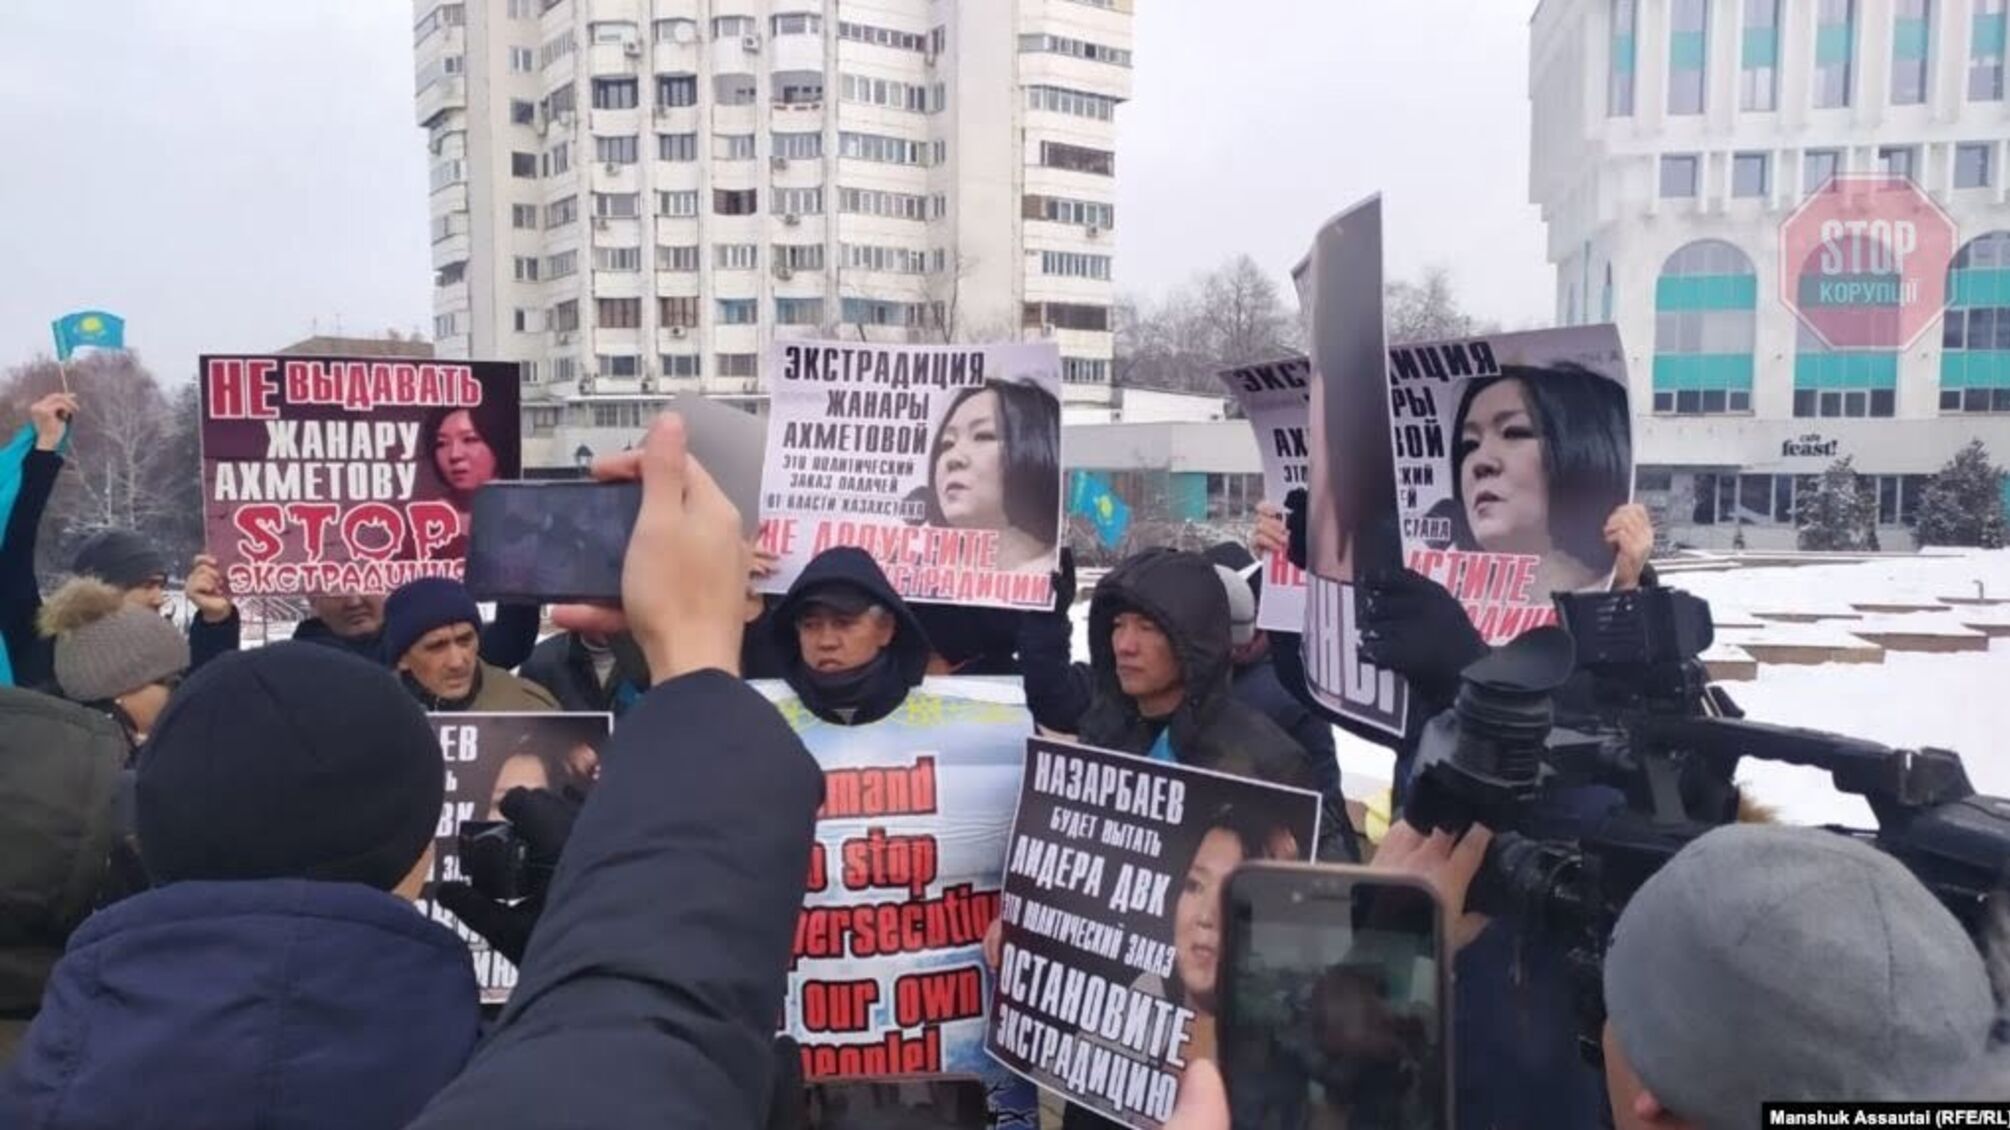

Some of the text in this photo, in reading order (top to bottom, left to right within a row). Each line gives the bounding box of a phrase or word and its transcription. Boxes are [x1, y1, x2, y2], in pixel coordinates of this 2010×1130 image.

[209, 358, 482, 419] НЕ ВЫДАВАТЬ
[784, 346, 985, 389] ЭКСТРАДИЦИЯ
[826, 389, 930, 421] ЖАНАРЫ
[266, 420, 419, 460] ЖАНАРУ
[783, 421, 928, 454] АХМЕТОВОЙ
[1782, 439, 1838, 457] feast!
[215, 462, 417, 500] АХМЕТОВУ
[782, 454, 914, 476] ЭТО ПОЛИТИЧЕСКИЙ
[790, 473, 898, 493] ЗАКАЗ ПАЛАЧЕЙ
[767, 493, 925, 517] ОТ ВЛАСТИ КАЗАХСТАНА
[234, 502, 461, 562] STOP
[761, 518, 798, 555] НЕ
[885, 565, 1051, 603] СТРАДИЦИИ
[816, 757, 937, 820] mand
[1033, 751, 1187, 825] НАЗАРБАЕВ
[1050, 805, 1163, 858] БУДЕТ ПЫТАТЬ
[842, 826, 938, 899] stop
[1010, 835, 1171, 918] ЛИДЕРА ДВК
[1022, 900, 1125, 961] ПОЛИТИЧЕСКИЙ
[1124, 933, 1177, 979] ЗАКАЗ
[802, 978, 880, 1034] our
[895, 966, 984, 1028] own
[1000, 942, 1195, 1068] ОСТАНОВИТЕ
[997, 1002, 1179, 1124] ЭКСТРАДИЦИЮ
